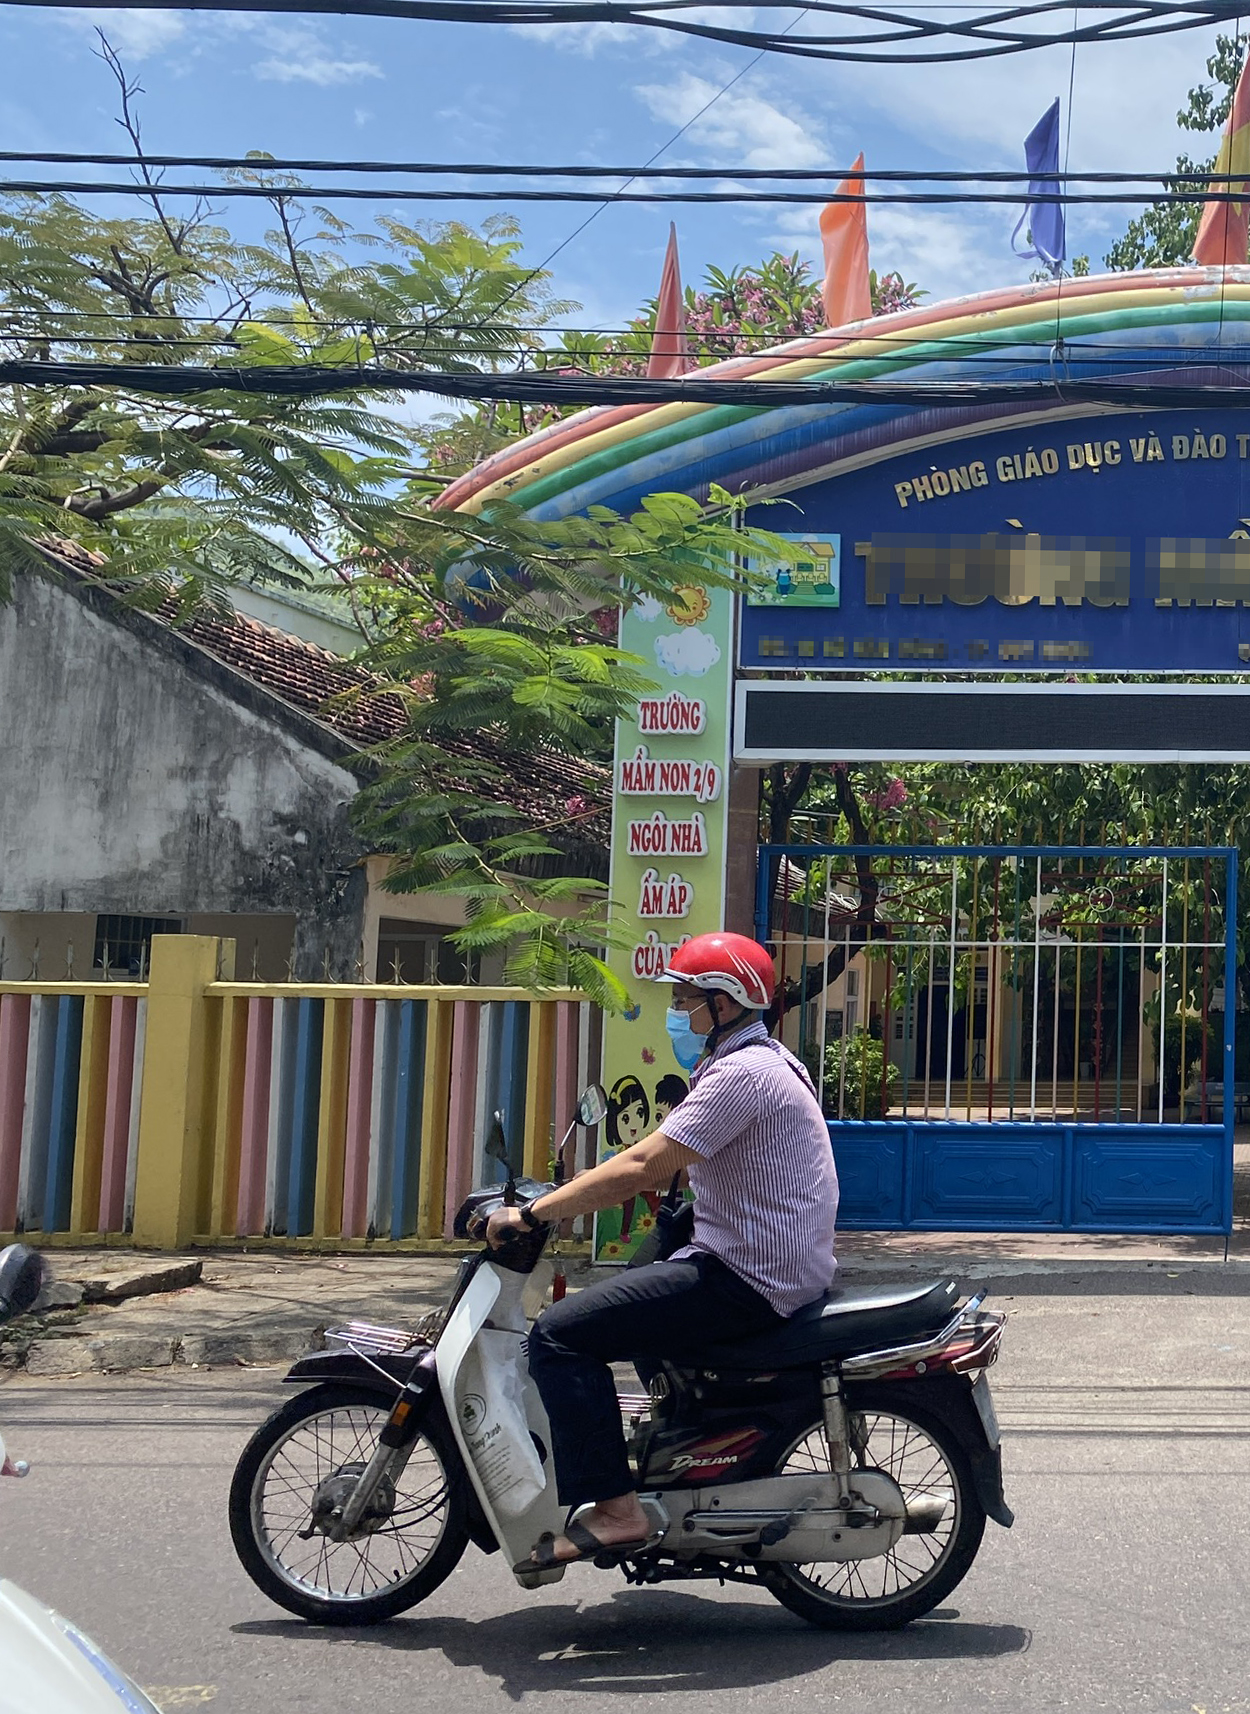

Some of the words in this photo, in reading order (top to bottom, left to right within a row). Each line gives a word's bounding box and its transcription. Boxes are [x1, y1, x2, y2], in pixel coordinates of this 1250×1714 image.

[894, 461, 989, 508] PHÒNG
[997, 445, 1060, 484] GIÁO
[1068, 439, 1123, 475] DỤC
[1130, 430, 1166, 462] VÀ
[1172, 429, 1227, 460] ĐÀO
[639, 694, 701, 731] TRƯỜNG
[621, 748, 656, 792] MẦM
[659, 763, 691, 792] NON
[693, 763, 716, 799] 2/9
[630, 815, 667, 852] NGÔI
[670, 815, 702, 852] NHÀ
[640, 871, 664, 915] ẤM
[666, 875, 688, 915] ÁP
[634, 934, 665, 976] CỦA
[668, 1454, 739, 1471] DREAM
